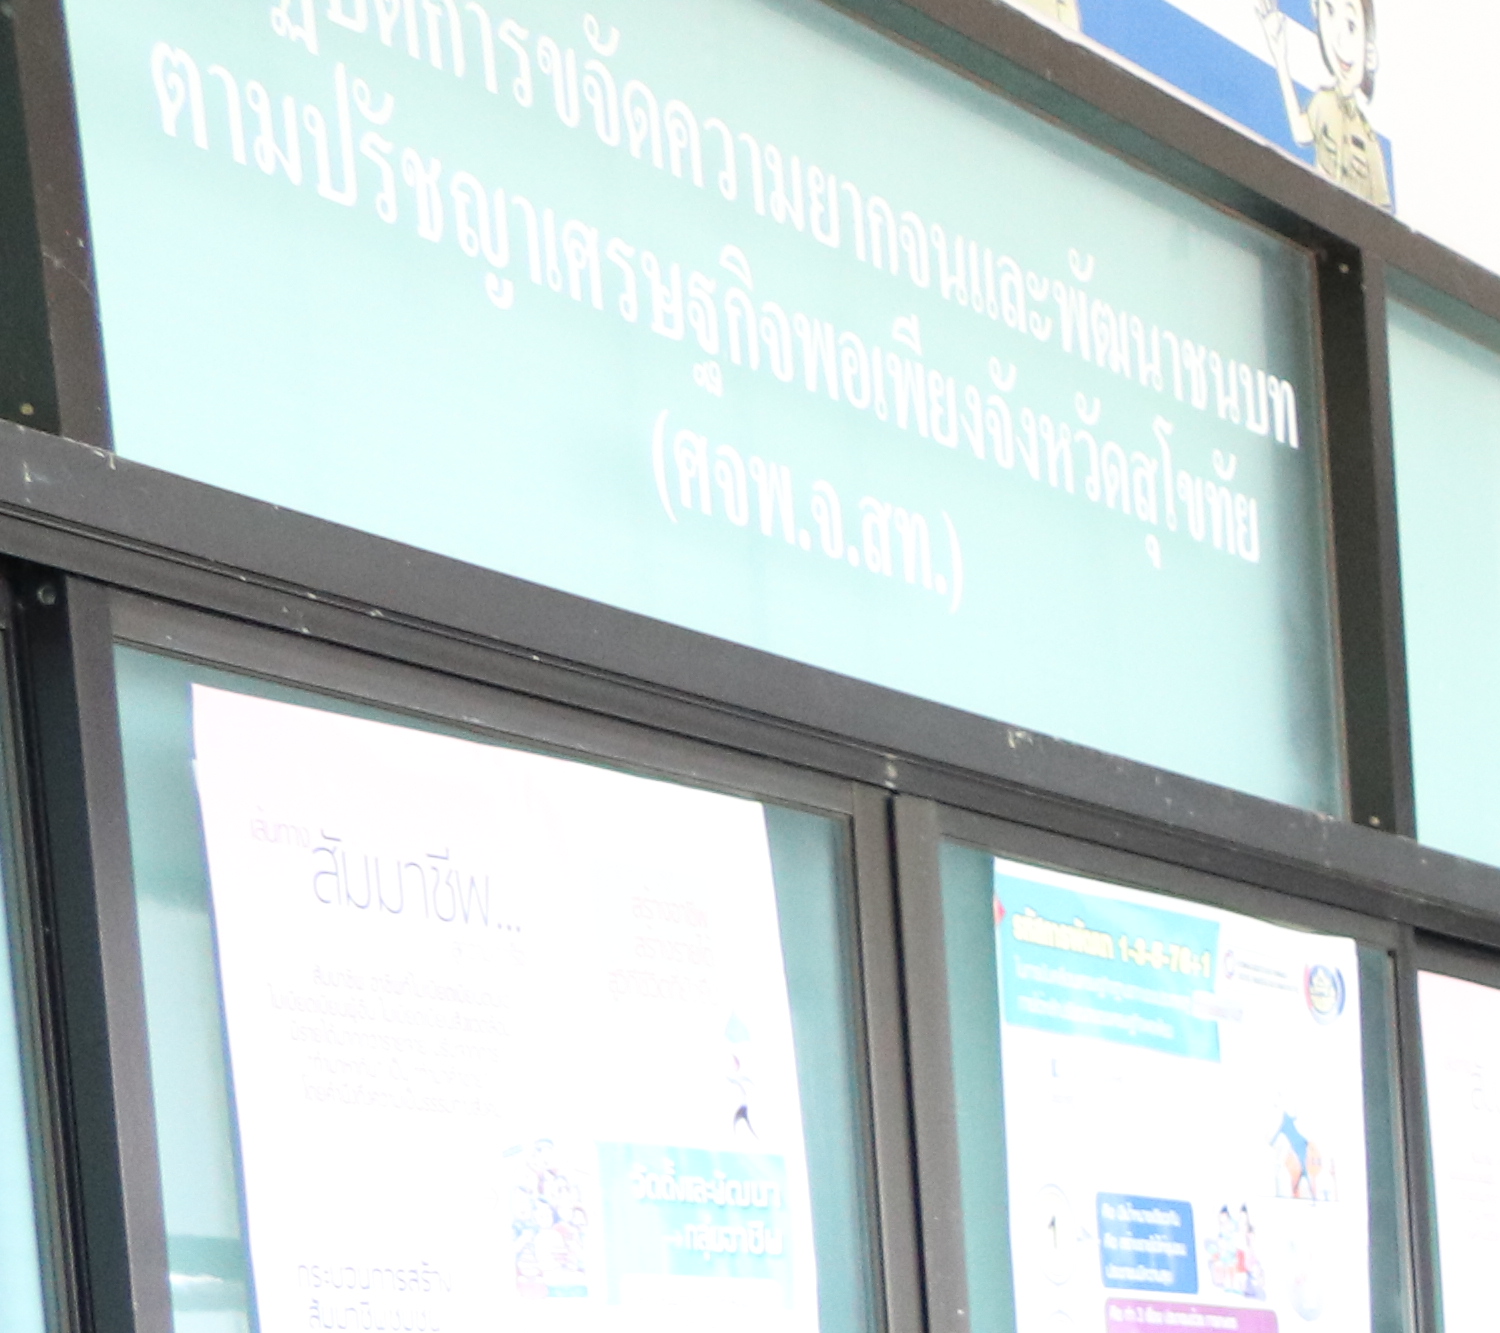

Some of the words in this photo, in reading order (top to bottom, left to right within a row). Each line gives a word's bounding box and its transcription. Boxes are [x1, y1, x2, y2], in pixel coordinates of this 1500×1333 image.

[150, 36, 1262, 571] ตามปรัชญาเศรษฐกิจพอเพียงจังหวัดสุโขทัย
[270, 0, 1300, 450] ตการขจัดความยากจนและพัฒนาชนบท
[651, 409, 966, 614] (ศจพ.จ.สท.)
